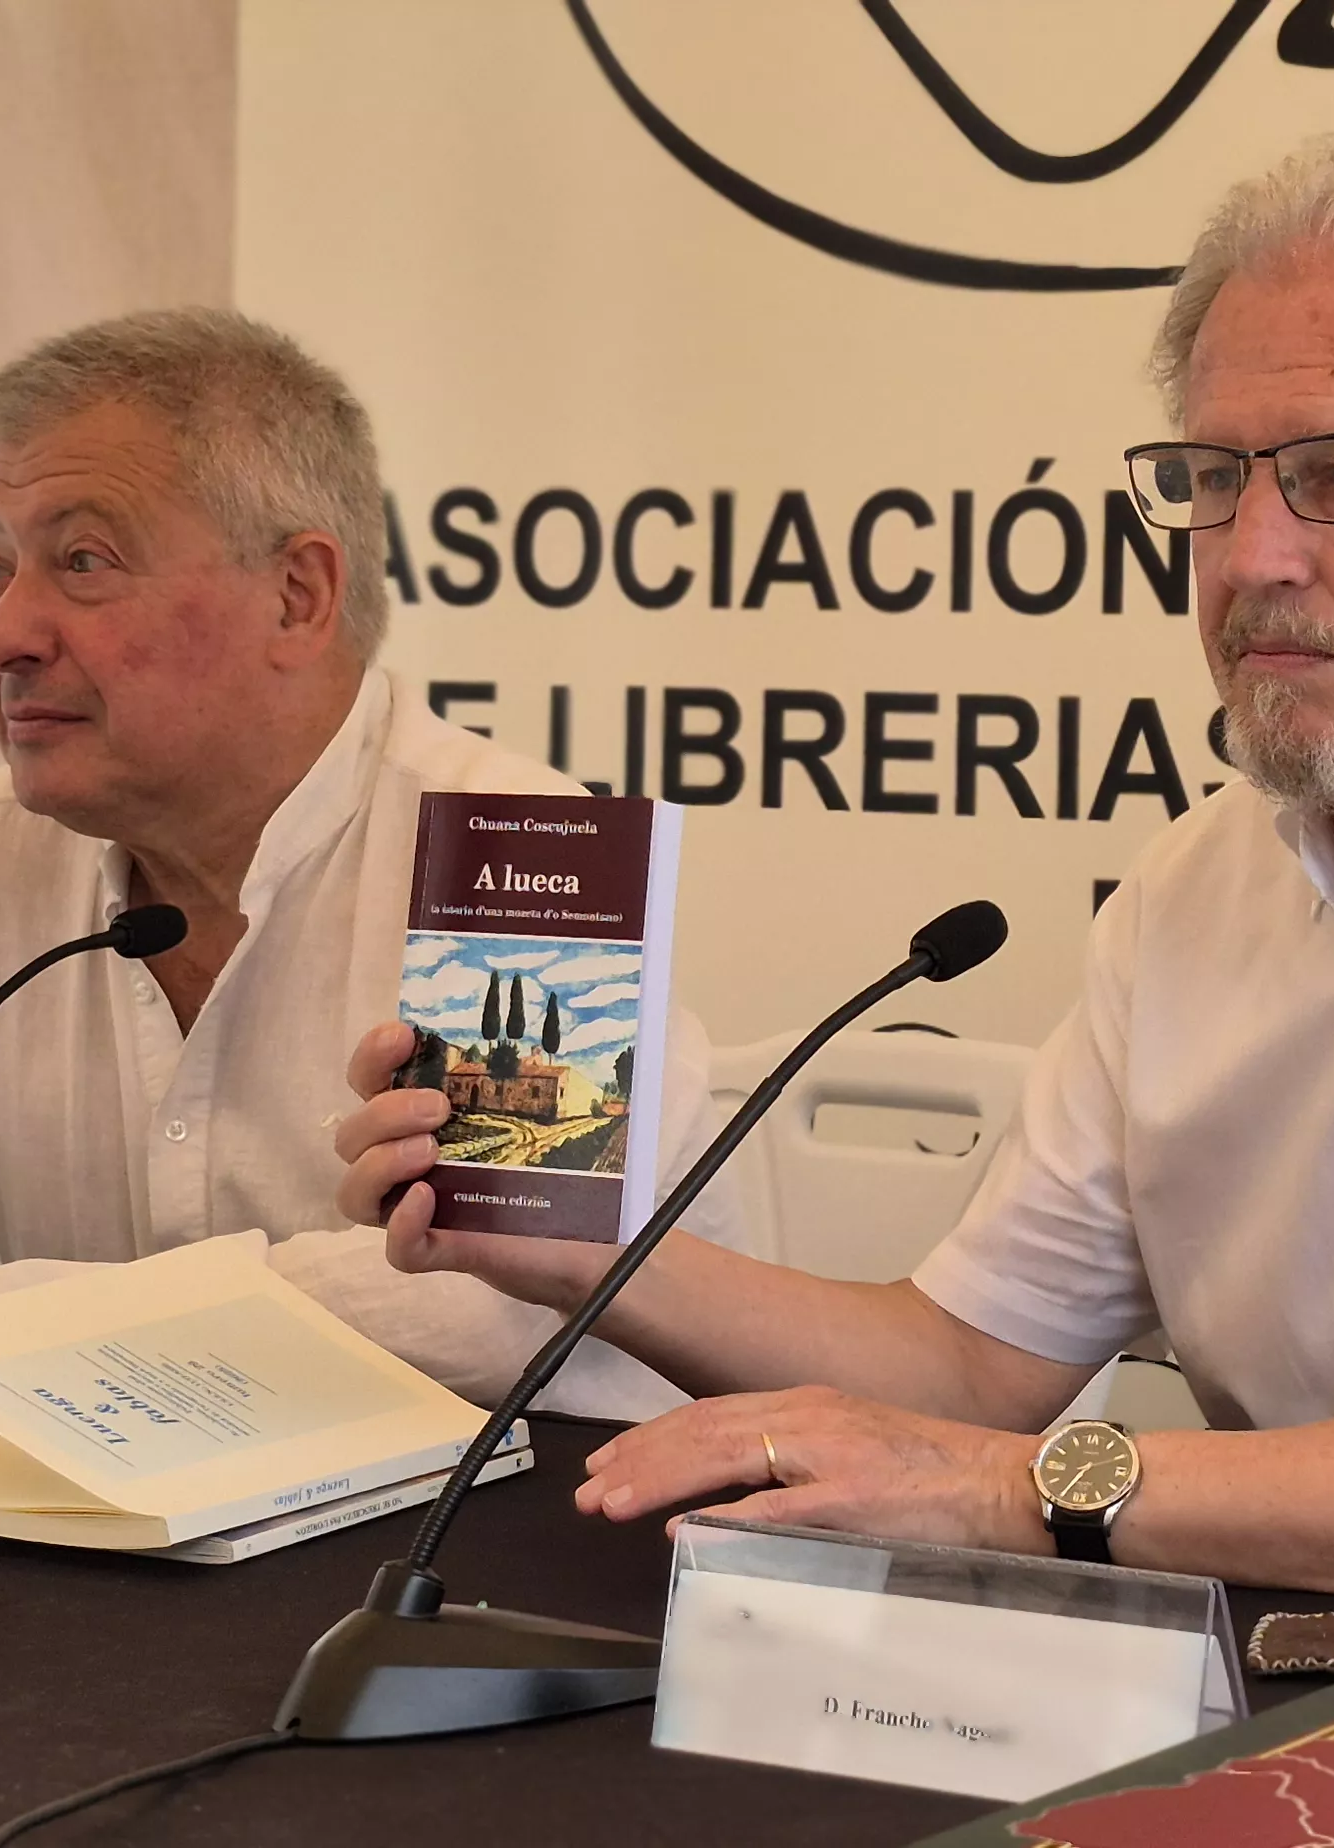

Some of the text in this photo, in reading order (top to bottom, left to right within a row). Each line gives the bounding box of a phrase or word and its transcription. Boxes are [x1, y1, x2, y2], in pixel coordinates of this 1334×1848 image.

[550, 681, 1233, 822] LIBRERIA
[469, 816, 520, 831] Chuana
[473, 863, 580, 894] A lueca
